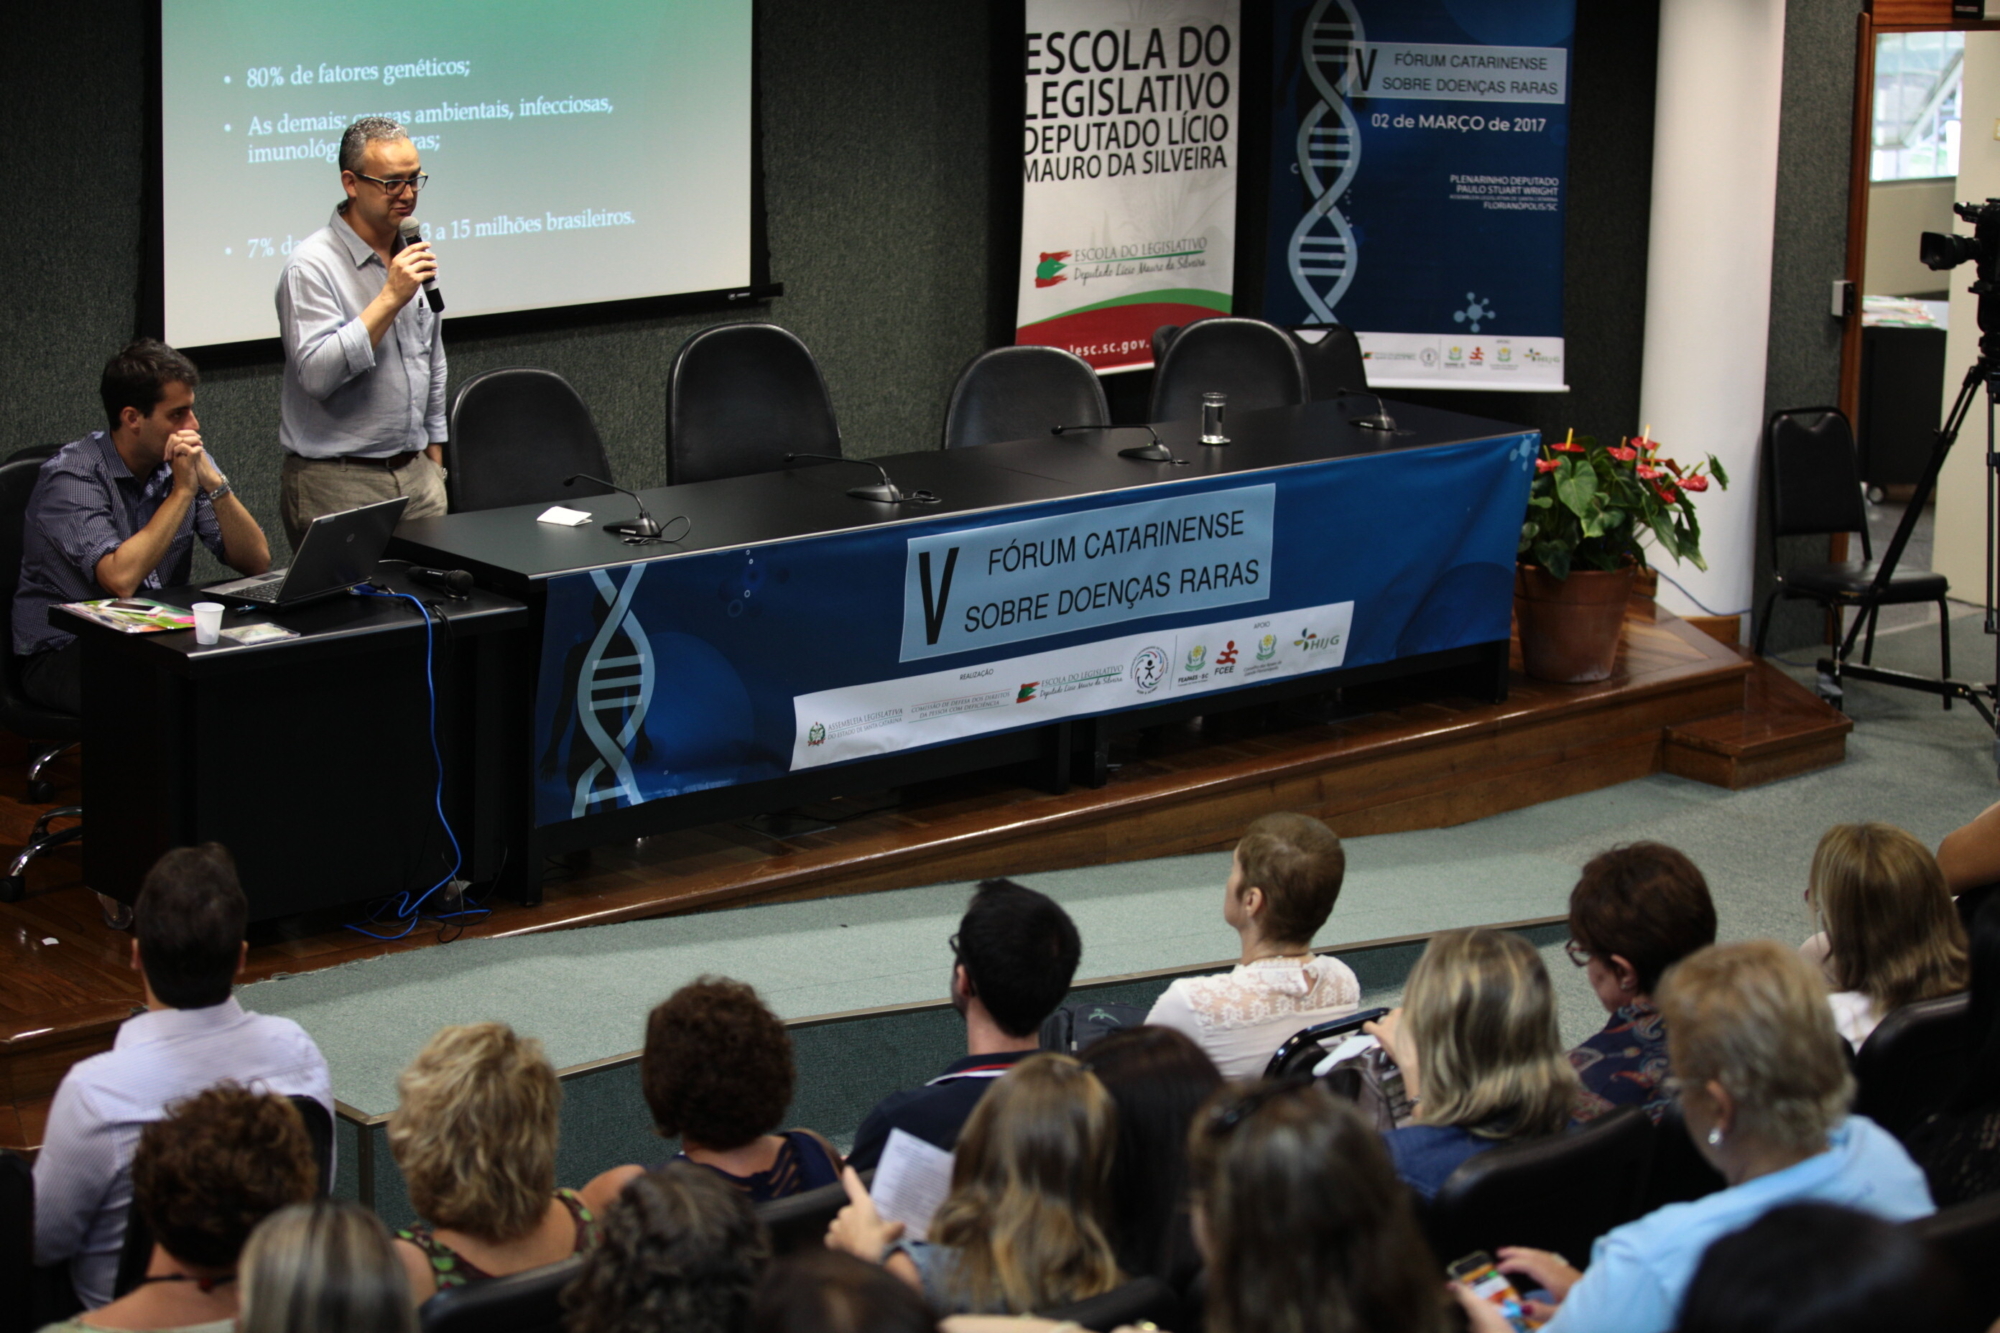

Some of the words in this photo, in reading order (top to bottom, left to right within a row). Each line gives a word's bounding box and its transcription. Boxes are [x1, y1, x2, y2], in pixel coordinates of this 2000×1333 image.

[1025, 28, 1166, 76] ESCOLA
[1178, 24, 1231, 68] DO
[1394, 50, 1446, 68] FÓRUM
[1450, 55, 1548, 71] CATARINENSE
[247, 66, 284, 88] 80%
[290, 65, 313, 85] de
[318, 63, 378, 84] fatores
[383, 58, 470, 86] genéticos;
[1355, 49, 1378, 91] V
[1025, 71, 1230, 121] LEGISLATIVO
[1382, 77, 1432, 91] SOBRE
[1436, 78, 1506, 96] DOENÇAS
[1511, 81, 1558, 95] RARAS
[247, 116, 272, 136] As
[277, 112, 347, 134] demais:
[415, 100, 514, 124] ambientais,
[519, 95, 613, 117] infecciosas,
[1371, 113, 1389, 128] 02
[1393, 114, 1415, 128] de
[1418, 114, 1485, 133] MARÇO
[1488, 117, 1510, 131] de
[1513, 117, 1546, 132] 2017
[1024, 118, 1160, 156] DEPUTADO
[1168, 110, 1229, 146] LÍCIO
[247, 137, 341, 163] imunológ
[411, 135, 440, 151] ras;
[1024, 154, 1101, 183] MAURO
[1107, 152, 1136, 177] DA
[1142, 145, 1227, 175] SILVEIRA
[1456, 184, 1486, 194] PAULO
[1488, 185, 1521, 195] STUART
[1521, 187, 1559, 196] WRIGHT
[1510, 176, 1559, 187] DEPUTADO
[247, 237, 275, 258] 7%
[436, 226, 446, 241] a
[451, 219, 470, 239] 15
[475, 215, 542, 238] milhões
[546, 208, 635, 232] brasileiros.
[1074, 247, 1117, 262] ESCOLA
[1120, 243, 1139, 258] DO
[1142, 237, 1207, 256] LEGISLATIVO
[987, 535, 1077, 576] FÓRUM
[1084, 509, 1245, 560] CATARINENSE
[918, 546, 960, 646] V
[964, 593, 1050, 633] SOBRE
[1057, 571, 1171, 616] DOENÇAS
[1179, 558, 1260, 595] RARAS
[959, 668, 994, 680] REALIZAÇÃO
[1068, 673, 1079, 682] DO
[1214, 665, 1235, 676] FCEE
